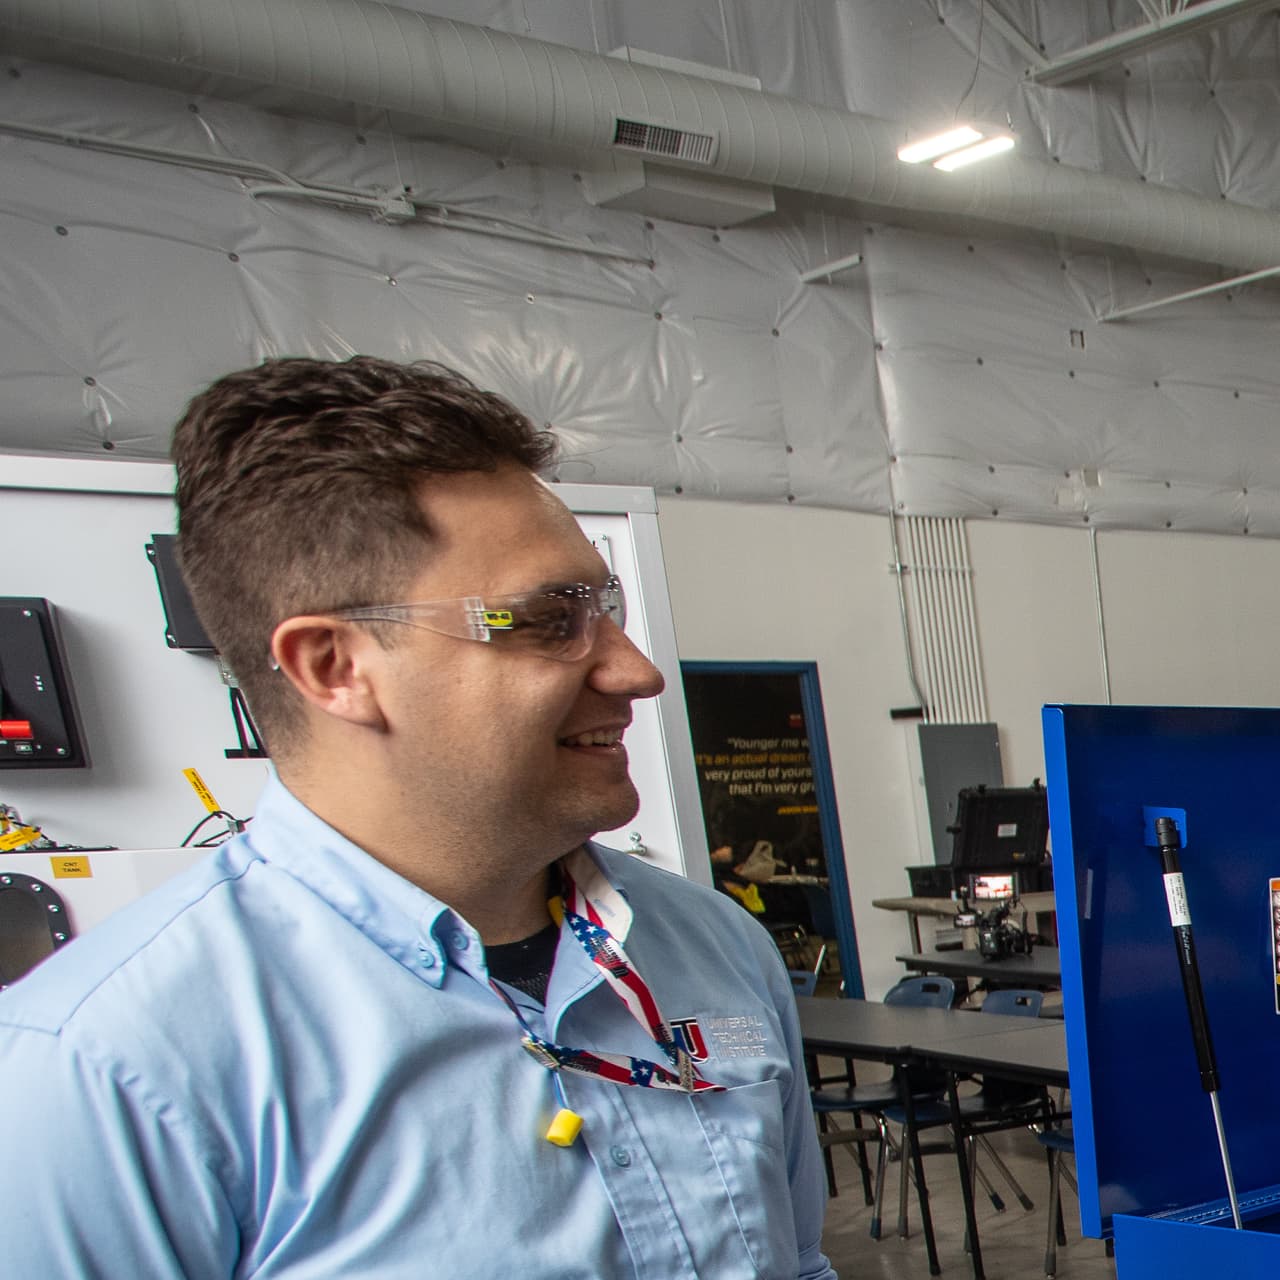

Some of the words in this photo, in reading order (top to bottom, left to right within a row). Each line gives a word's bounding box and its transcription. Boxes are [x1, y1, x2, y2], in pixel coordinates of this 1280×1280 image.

[781, 738, 799, 748] me
[705, 769, 729, 782] very
[732, 768, 766, 781] proud
[767, 767, 780, 779] of
[729, 783, 753, 795] that
[754, 782, 772, 794] I'm
[774, 782, 798, 795] very
[708, 1016, 763, 1028] UNIVERSAL
[712, 1030, 768, 1043] TECHNICAL
[719, 1045, 767, 1057] INSTITUTE
